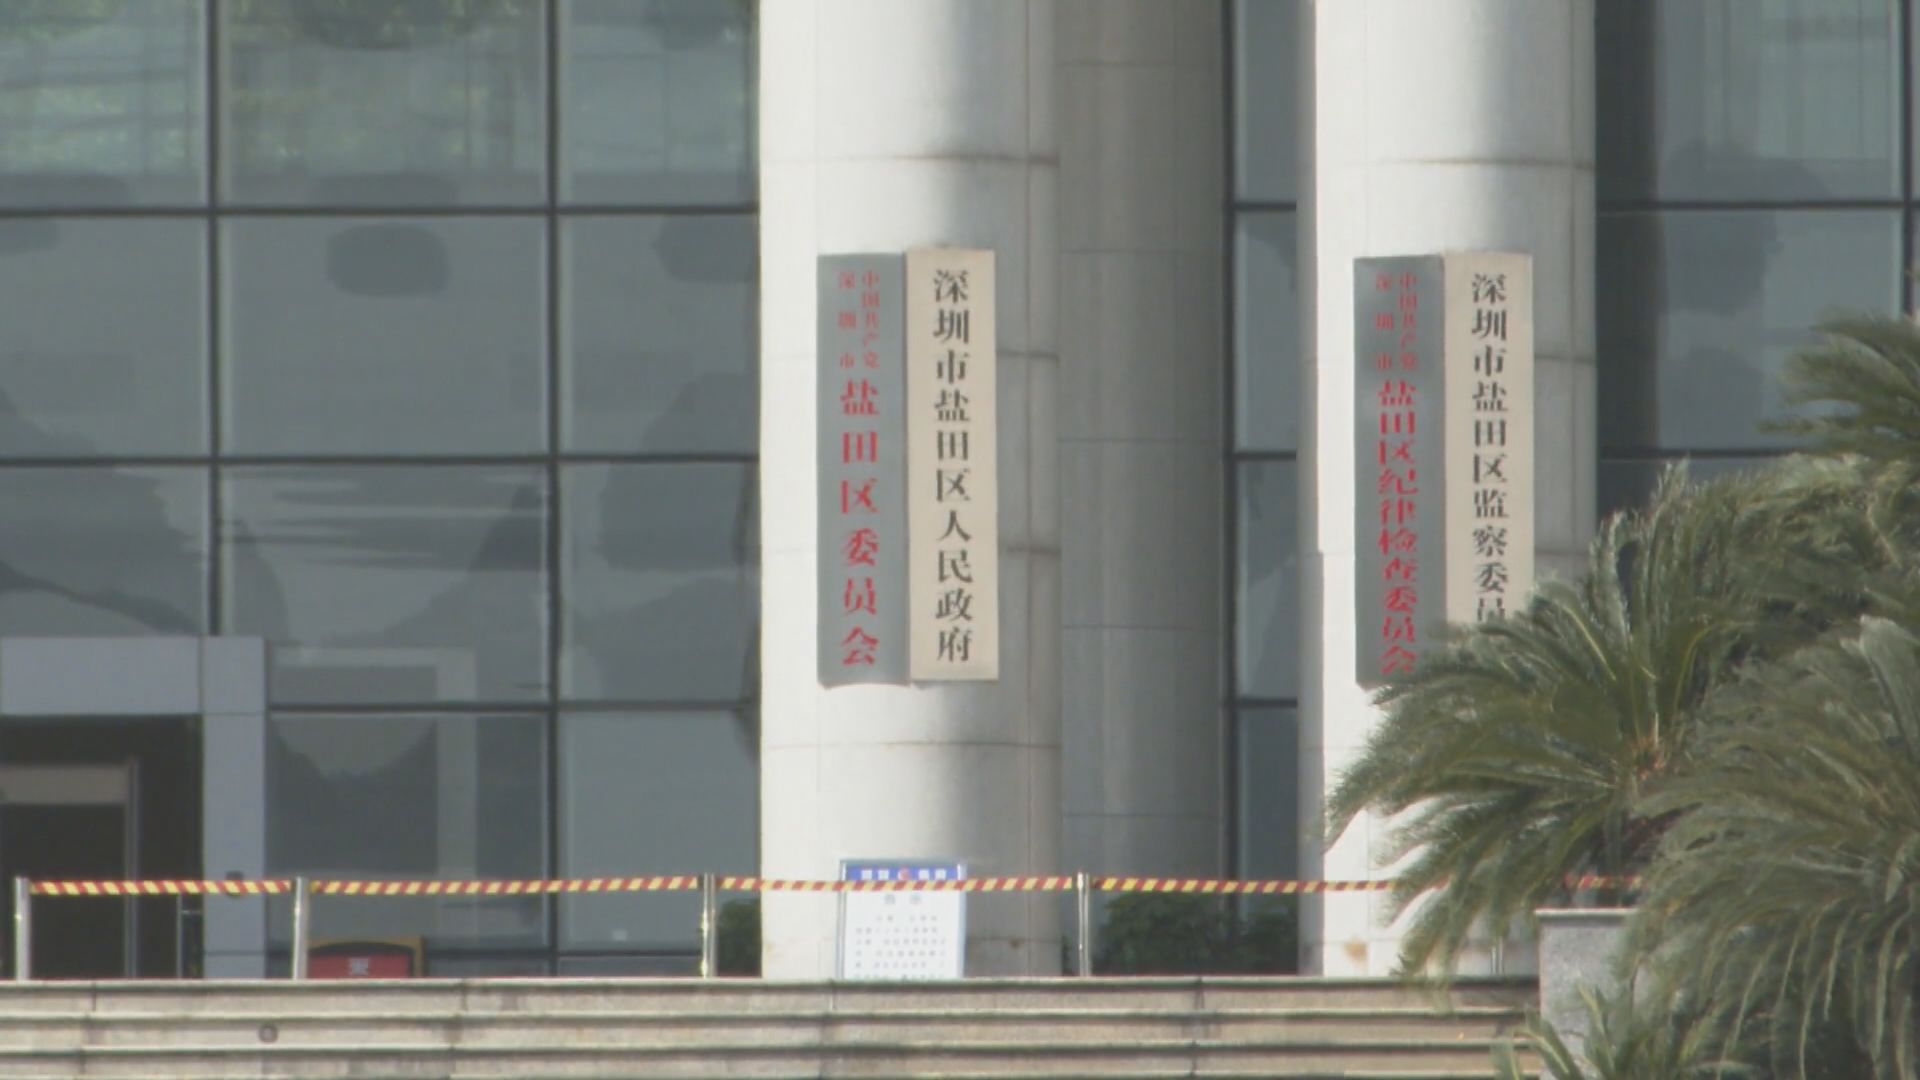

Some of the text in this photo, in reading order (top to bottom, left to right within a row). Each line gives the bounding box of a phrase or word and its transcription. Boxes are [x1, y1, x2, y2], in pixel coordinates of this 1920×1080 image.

[840, 379, 879, 666] 盐田区委员会
[932, 269, 974, 662] 深圳市盐田区人民政府
